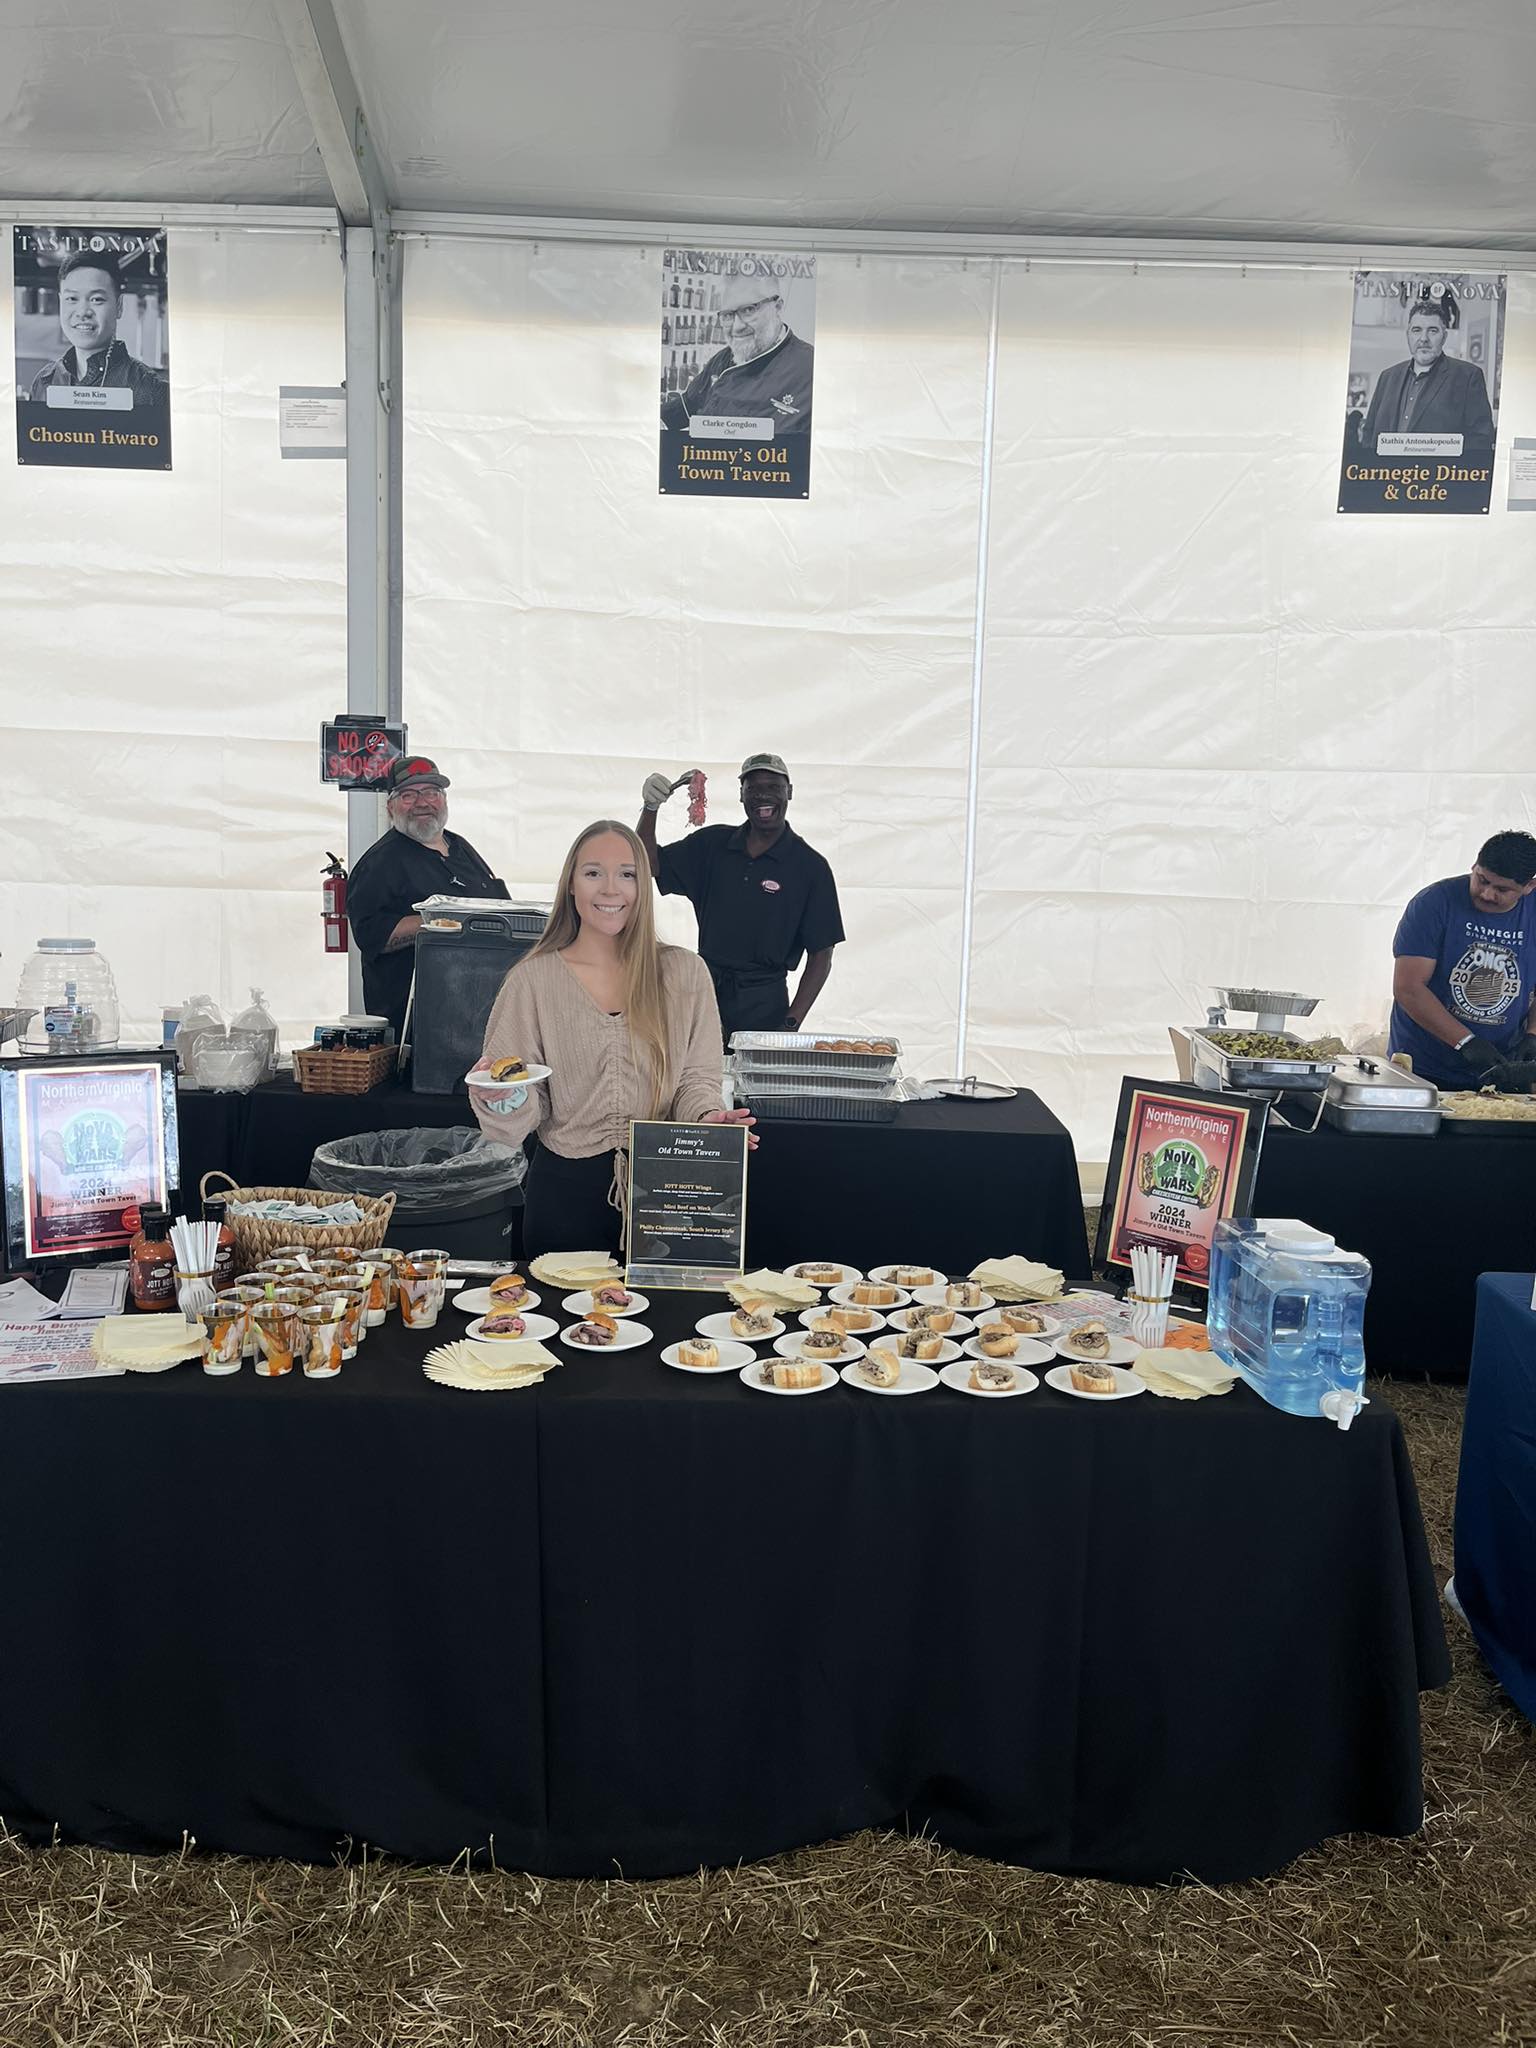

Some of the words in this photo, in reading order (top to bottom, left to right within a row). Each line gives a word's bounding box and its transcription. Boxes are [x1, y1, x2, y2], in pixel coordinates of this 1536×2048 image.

[18, 235, 90, 252] TASTE
[73, 390, 91, 398] Sean
[92, 391, 108, 399] Kim
[702, 419, 725, 428] Clarke
[726, 421, 758, 430] Congdon
[29, 426, 96, 444] Chosun
[101, 429, 159, 447] Hwaro
[1380, 437, 1405, 445] Stathis
[681, 445, 752, 465] Jimmy’s
[757, 448, 788, 464] Old
[678, 464, 725, 481] Town
[730, 467, 791, 483] Tavern
[1346, 464, 1430, 484] Carnegie
[1435, 465, 1489, 481] Diner
[1384, 484, 1399, 500] &
[1406, 485, 1448, 501] Cafe
[336, 731, 360, 752] NO
[327, 756, 396, 778] SMOKIN
[1465, 922, 1525, 940] CARNEGIE
[1473, 949, 1508, 973] OMG
[1452, 972, 1468, 984] 20
[1503, 982, 1518, 994] 25
[1146, 1107, 1230, 1135] NorthernVirginia
[1145, 1120, 1228, 1144] MAGAZINE
[657, 1146, 671, 1154] Old
[673, 1147, 693, 1155] Town
[695, 1148, 721, 1157] Tavern
[1164, 1148, 1198, 1169] NoVA
[70, 1187, 123, 1200] WINNER
[1160, 1176, 1196, 1194] WARS
[96, 1195, 117, 1204] Town
[1149, 1211, 1192, 1230] WINNER
[1158, 1204, 1186, 1219] 2024
[639, 1224, 655, 1232] Philly
[1167, 1226, 1185, 1235] Town
[1185, 1229, 1207, 1240] Tavern
[5, 1323, 46, 1332] Happy
